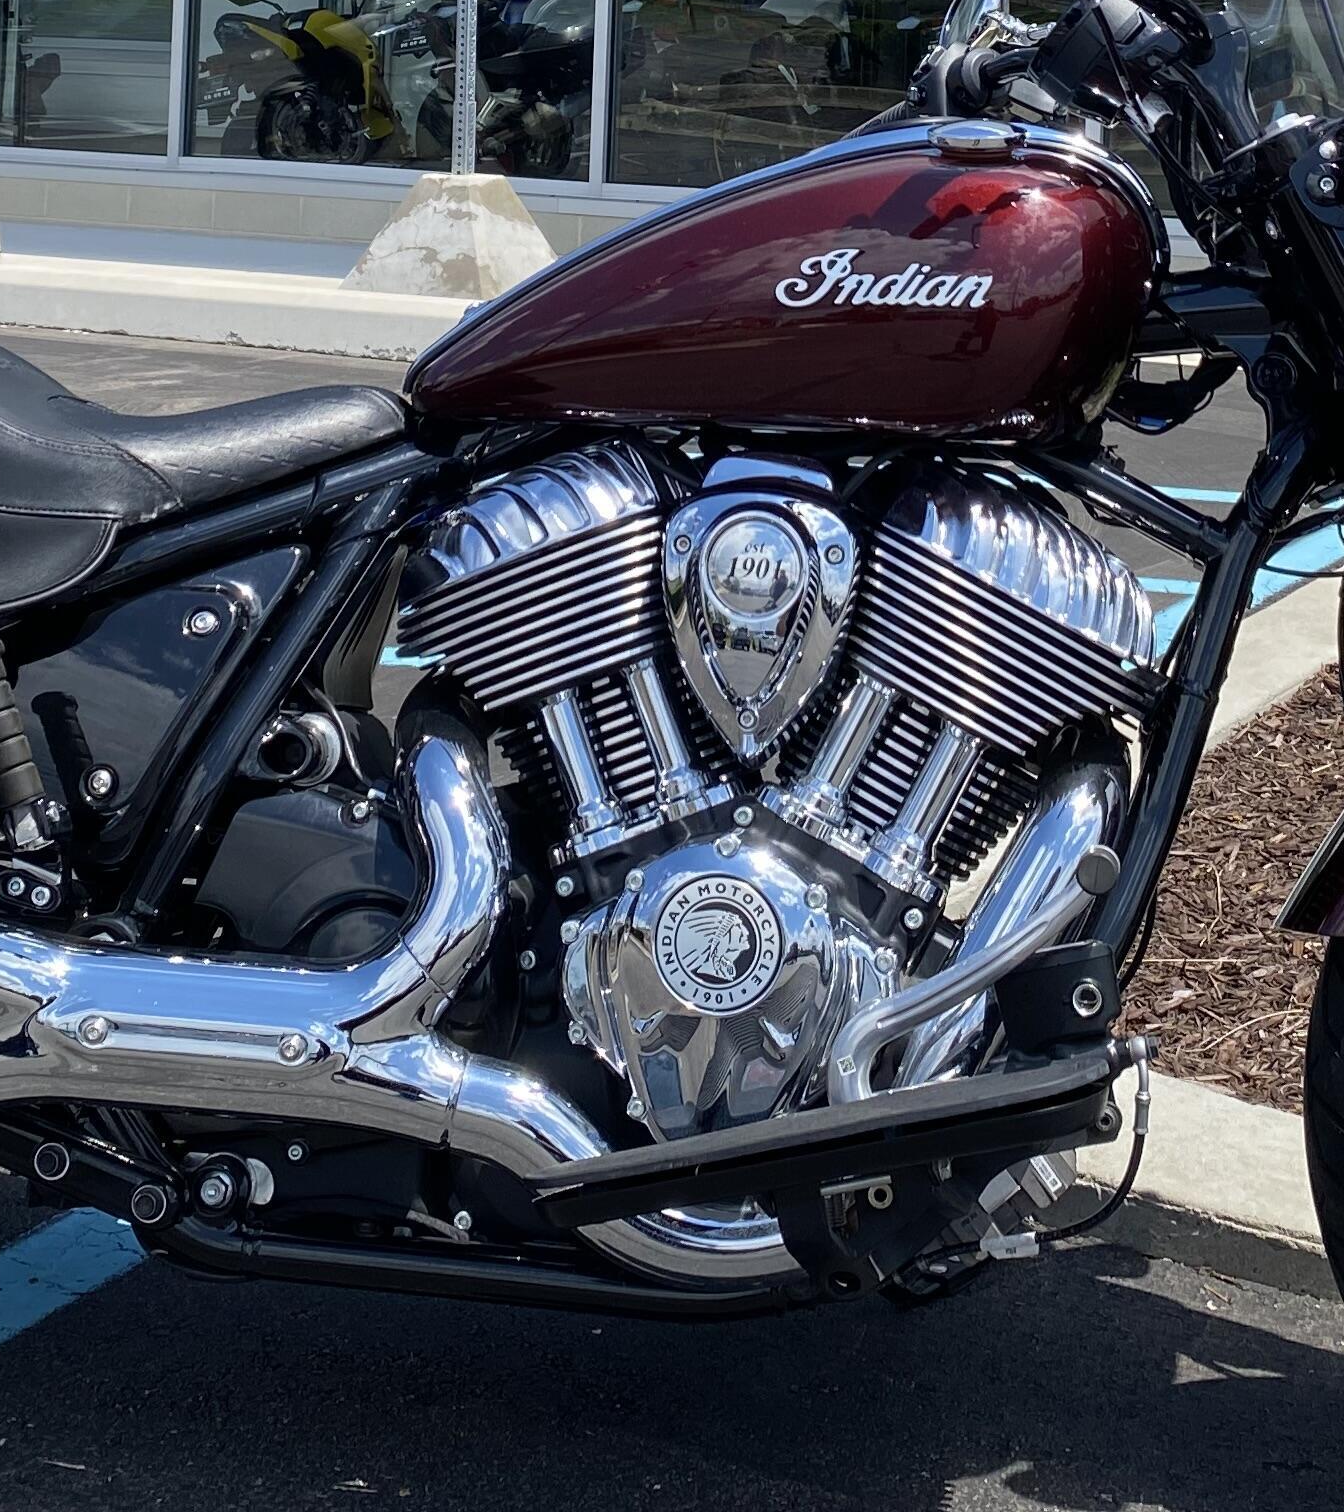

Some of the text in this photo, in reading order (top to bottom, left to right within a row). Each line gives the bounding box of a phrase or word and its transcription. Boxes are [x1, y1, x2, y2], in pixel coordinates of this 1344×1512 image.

[774, 248, 994, 309] Indian
[743, 541, 766, 554] est
[727, 556, 783, 580] 1901
[661, 883, 776, 986] INDIAN MOTORCYCLE
[692, 988, 734, 1004] 1901
